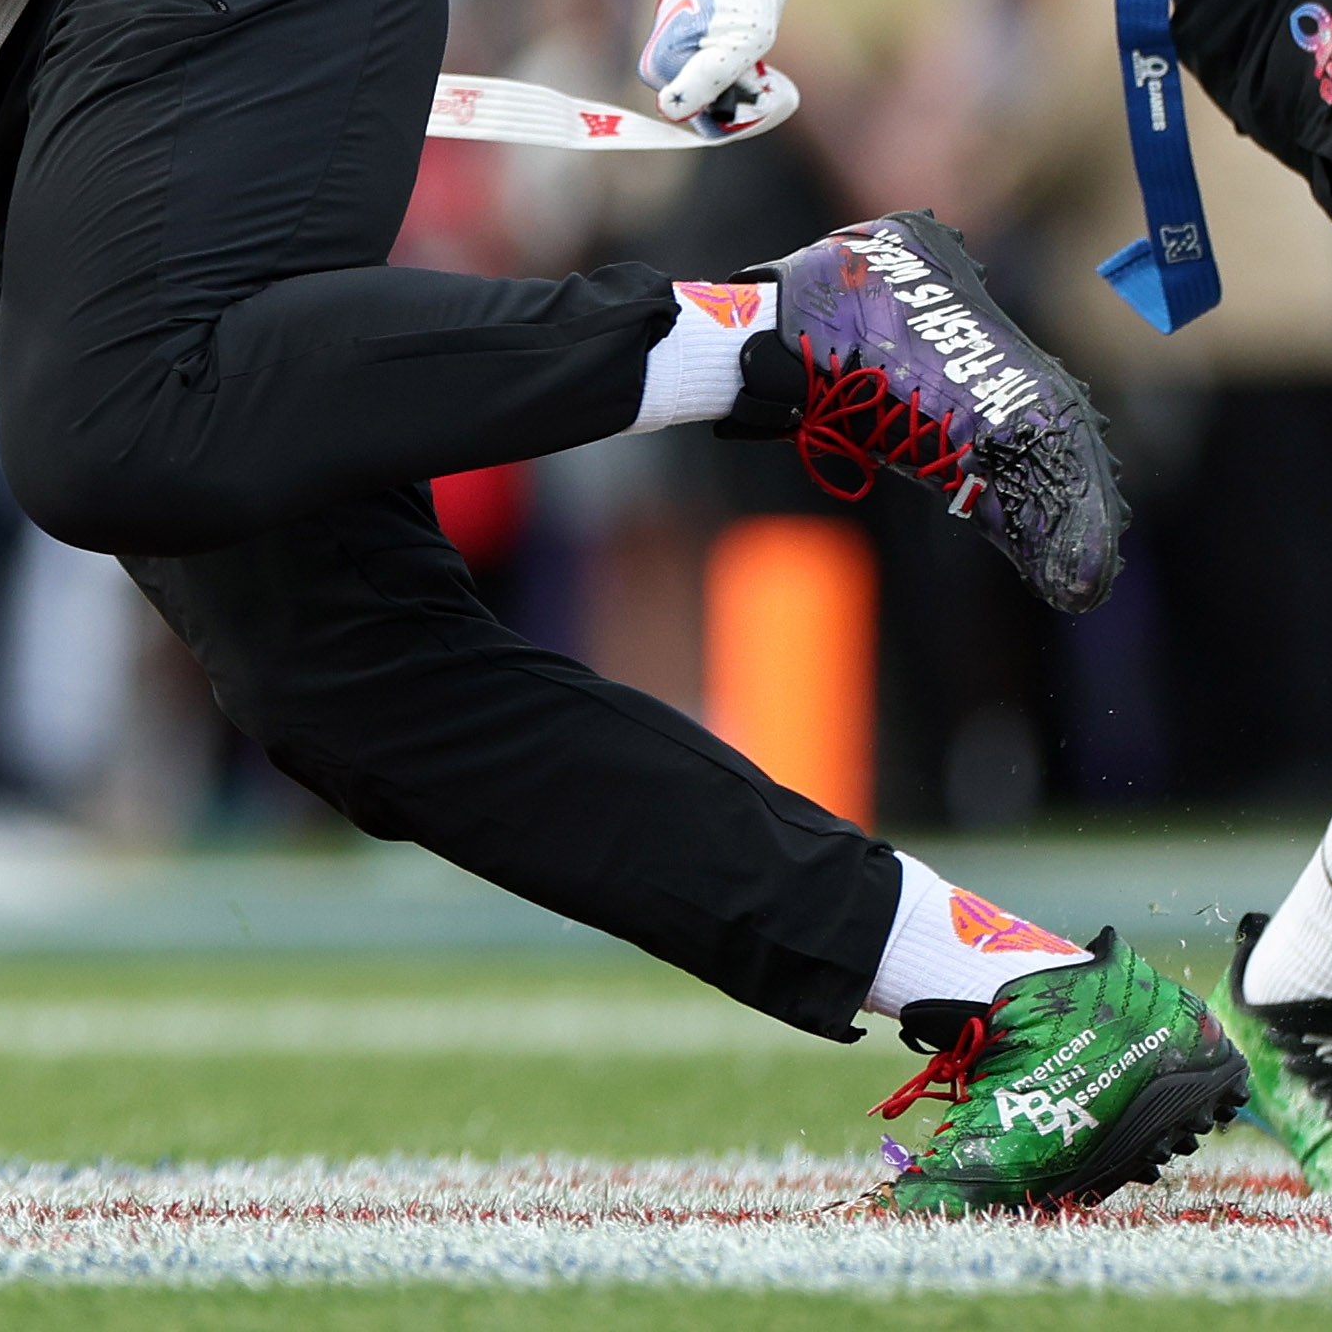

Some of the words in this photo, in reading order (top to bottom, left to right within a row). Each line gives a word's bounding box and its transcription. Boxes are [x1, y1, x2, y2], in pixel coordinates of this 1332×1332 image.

[842, 228, 931, 284] WEAK
[894, 283, 954, 308] IS
[906, 304, 1005, 384] FLESH
[971, 367, 1039, 425] THE
